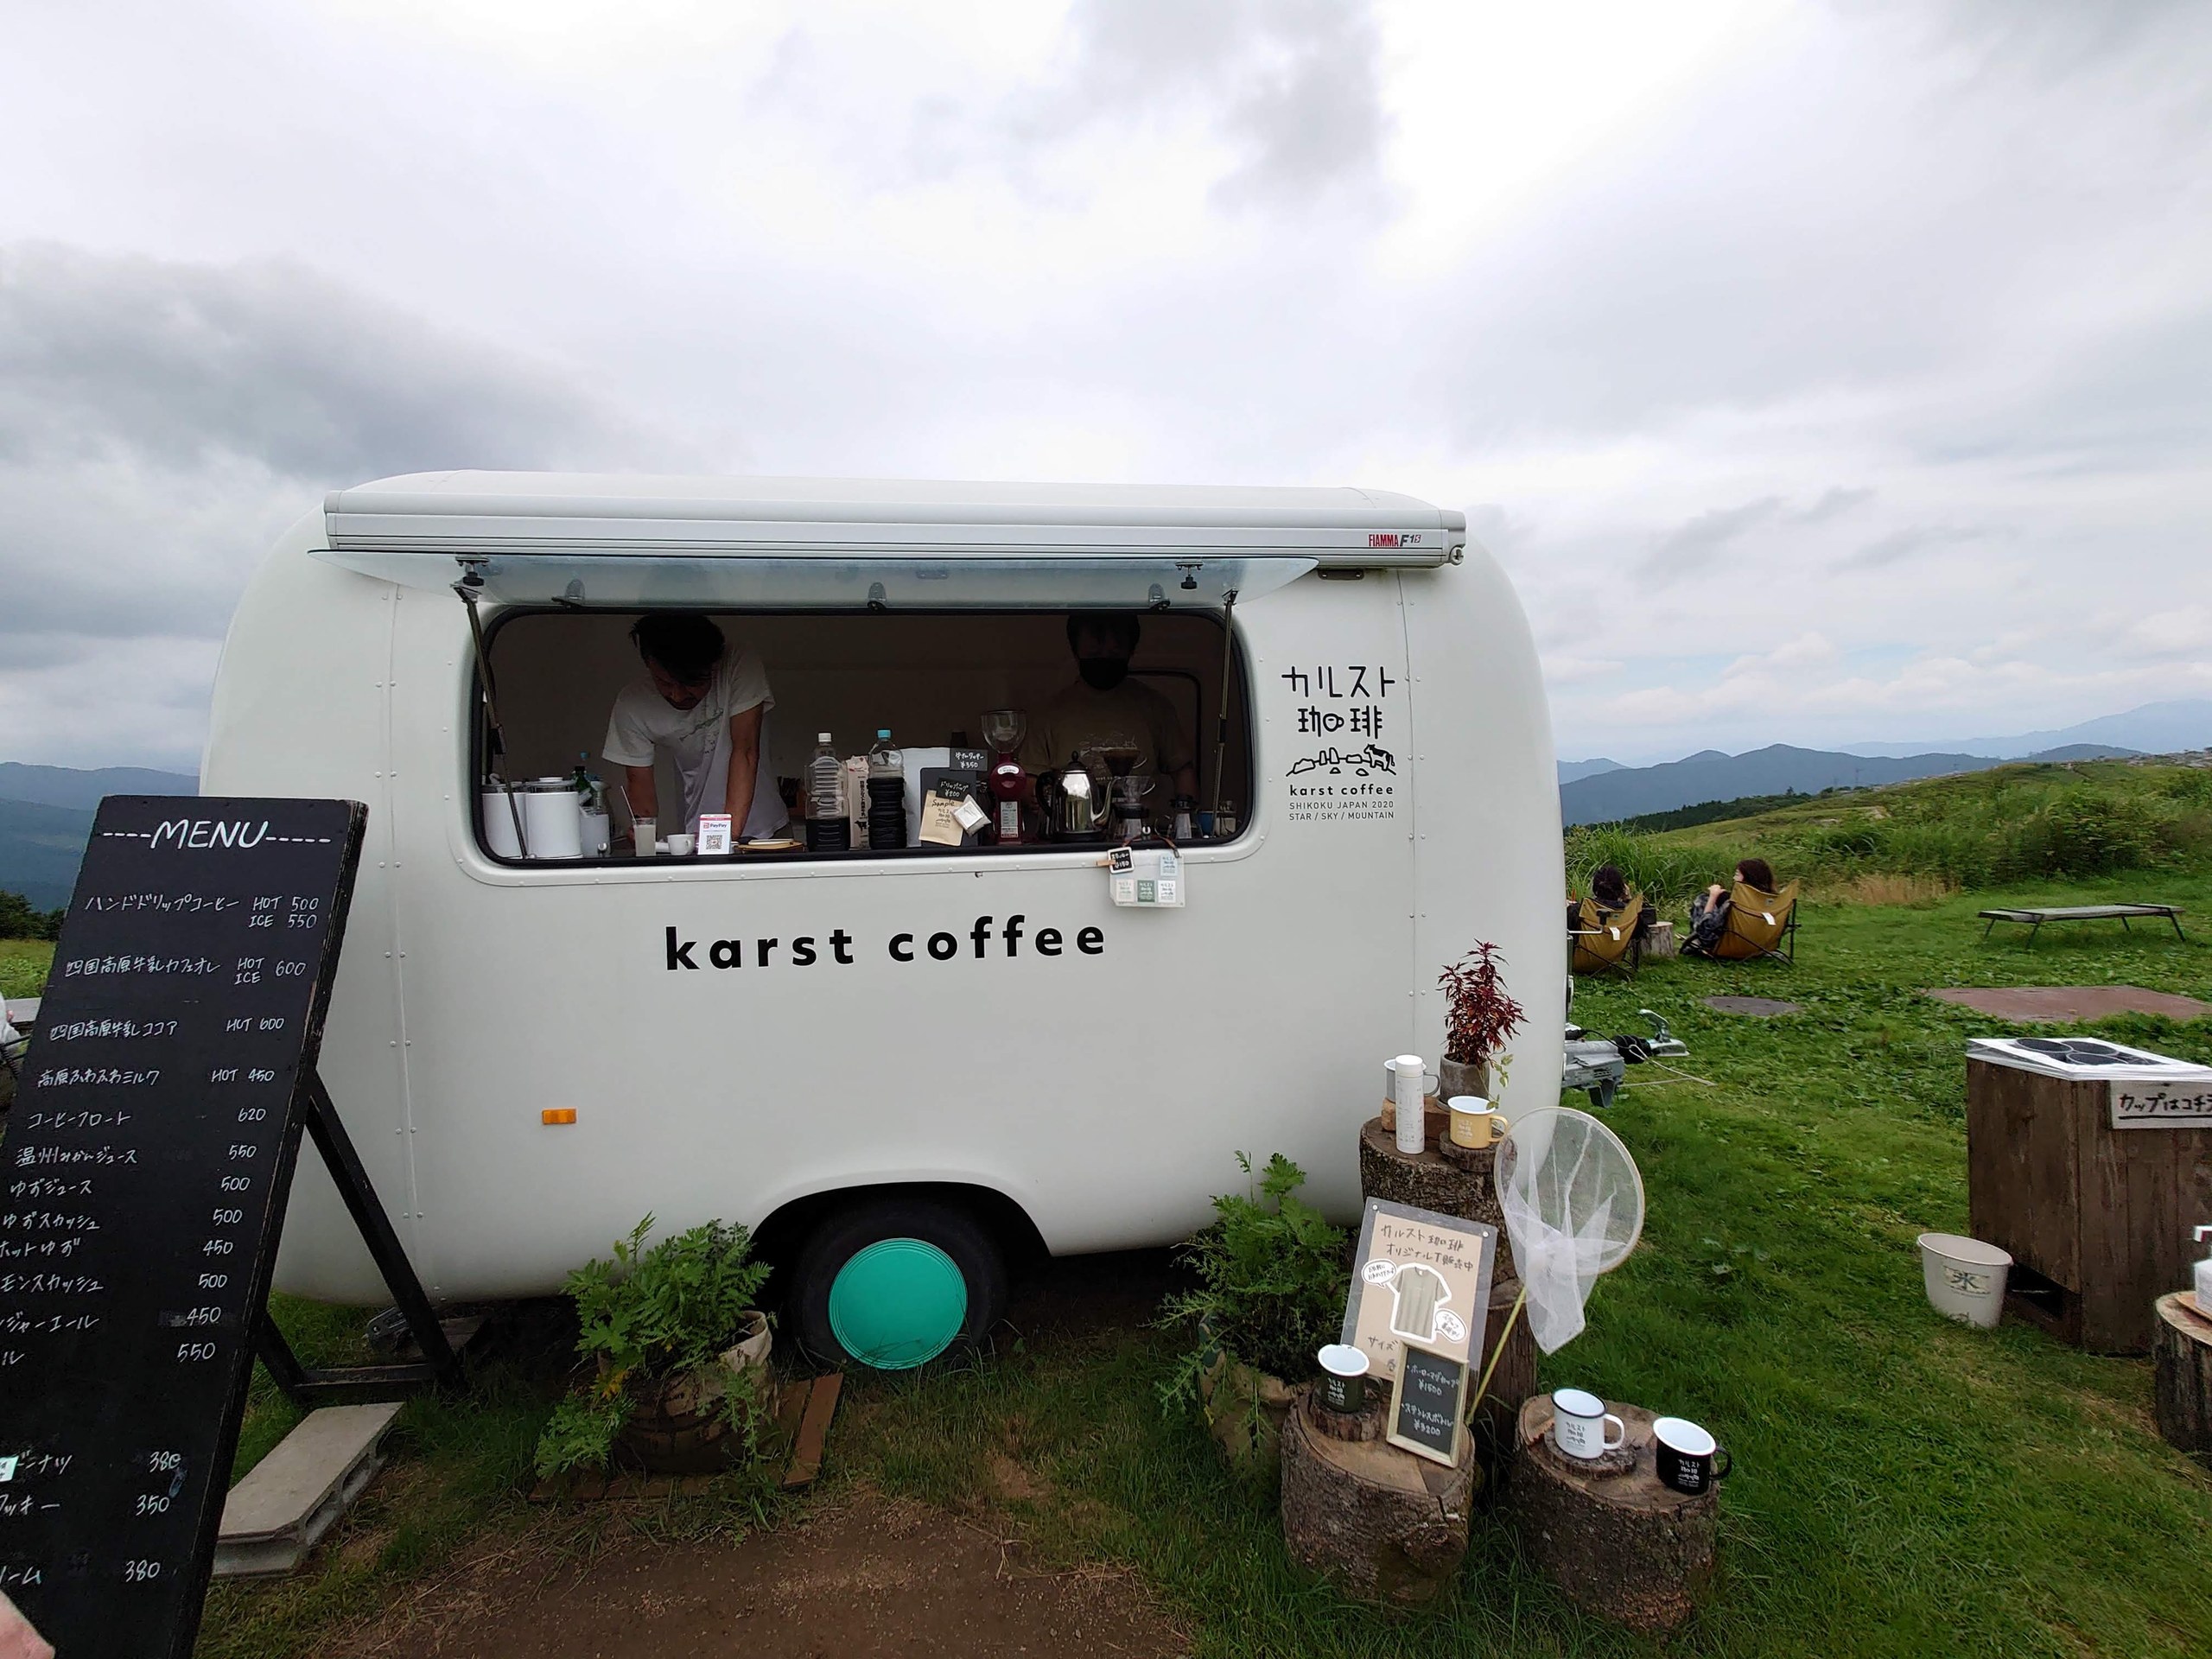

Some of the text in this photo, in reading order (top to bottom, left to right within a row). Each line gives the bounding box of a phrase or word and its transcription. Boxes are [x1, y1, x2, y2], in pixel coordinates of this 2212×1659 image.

[1368, 534, 1399, 547] FIAMMA
[1281, 665, 1395, 697] カルスト
[1298, 705, 1382, 740] 珈琲
[1290, 783, 1394, 796] karst coffee
[931, 798, 955, 808] Sample
[1337, 801, 1368, 810] JAPAN
[1371, 800, 1394, 809] 2020
[1289, 812, 1312, 821] STAR
[1321, 811, 1338, 821] SKY
[1348, 810, 1394, 820] MOUNTAIN
[150, 819, 270, 849] MENU
[85, 893, 319, 912] ハンドドリップコーヒー HOT 500
[248, 914, 317, 929] ICE 550
[665, 914, 1105, 970] karst coffee
[65, 955, 306, 978] 四国高原牛乳カフェオレ HOT 600
[233, 972, 262, 985] ICE
[49, 1017, 285, 1040] 四国高原牛乳ココア HOT 600
[37, 1068, 276, 1088] 高原ふわふわミルク HOT 450
[28, 1108, 267, 1129] コーヒーフロート 620
[15, 1145, 257, 1167] 温州みかんジュース 550
[10, 1176, 251, 1198] ゆずジュース 500
[3, 1208, 243, 1230] ゆずスカッシュ 500
[202, 1240, 233, 1256] 450
[198, 1274, 228, 1292] 500
[186, 1306, 222, 1325] 450
[176, 1342, 216, 1363] 550
[1368, 1336, 1398, 1351] サイズ
[135, 1496, 170, 1516] 350
[124, 1560, 161, 1583] 380
